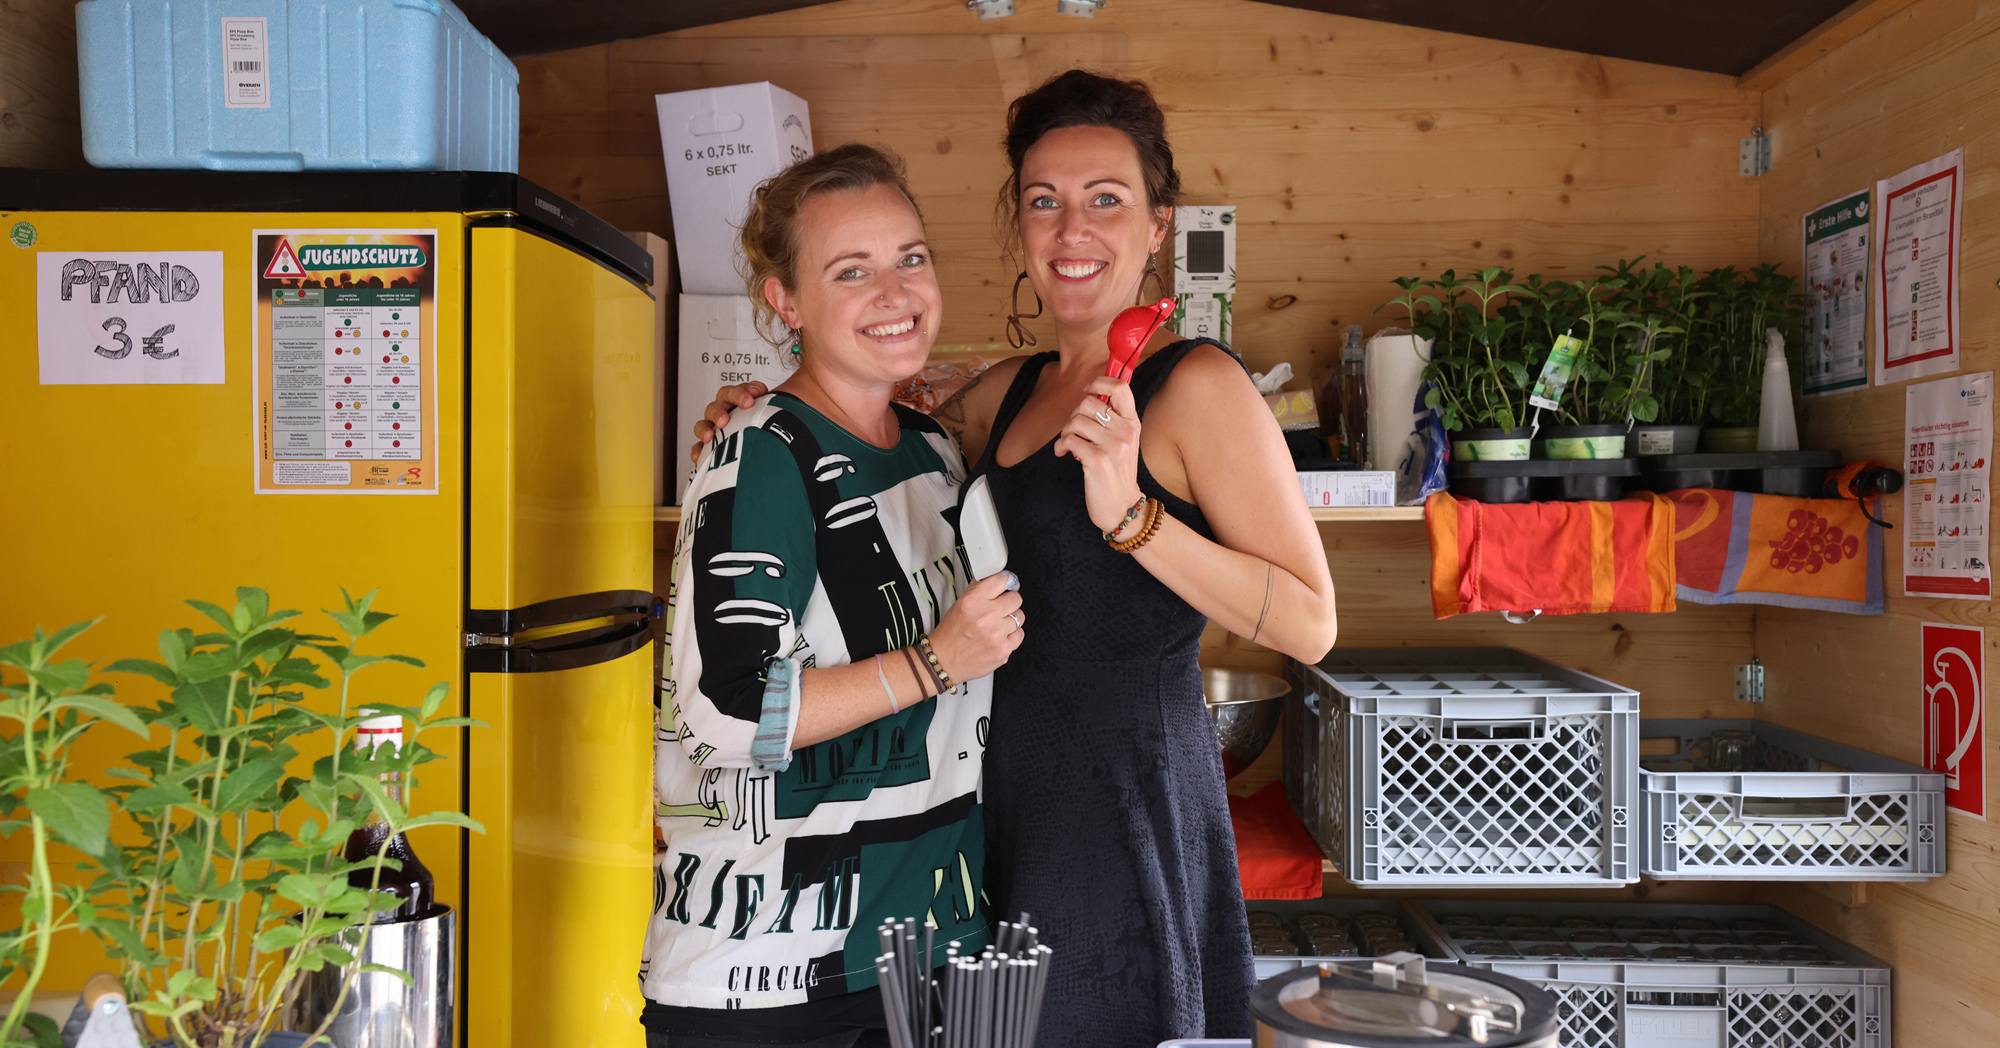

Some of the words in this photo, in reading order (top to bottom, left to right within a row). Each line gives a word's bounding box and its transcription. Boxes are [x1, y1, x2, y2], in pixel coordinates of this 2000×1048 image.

[685, 149, 693, 161] 6
[696, 151, 703, 159] x
[707, 144, 734, 161] 0,75
[737, 143, 754, 155] ltr.
[706, 164, 737, 177] SEKT
[302, 248, 419, 266] JUGENDSCHUTZ
[61, 258, 200, 304] PFAND
[94, 316, 133, 360] 3
[142, 323, 180, 360] €
[701, 352, 710, 365] 6
[713, 355, 720, 365] x
[724, 352, 751, 367] 0,75
[755, 353, 770, 366] ltr.
[720, 371, 752, 382] SEKT
[728, 962, 820, 993] CIRCLE
